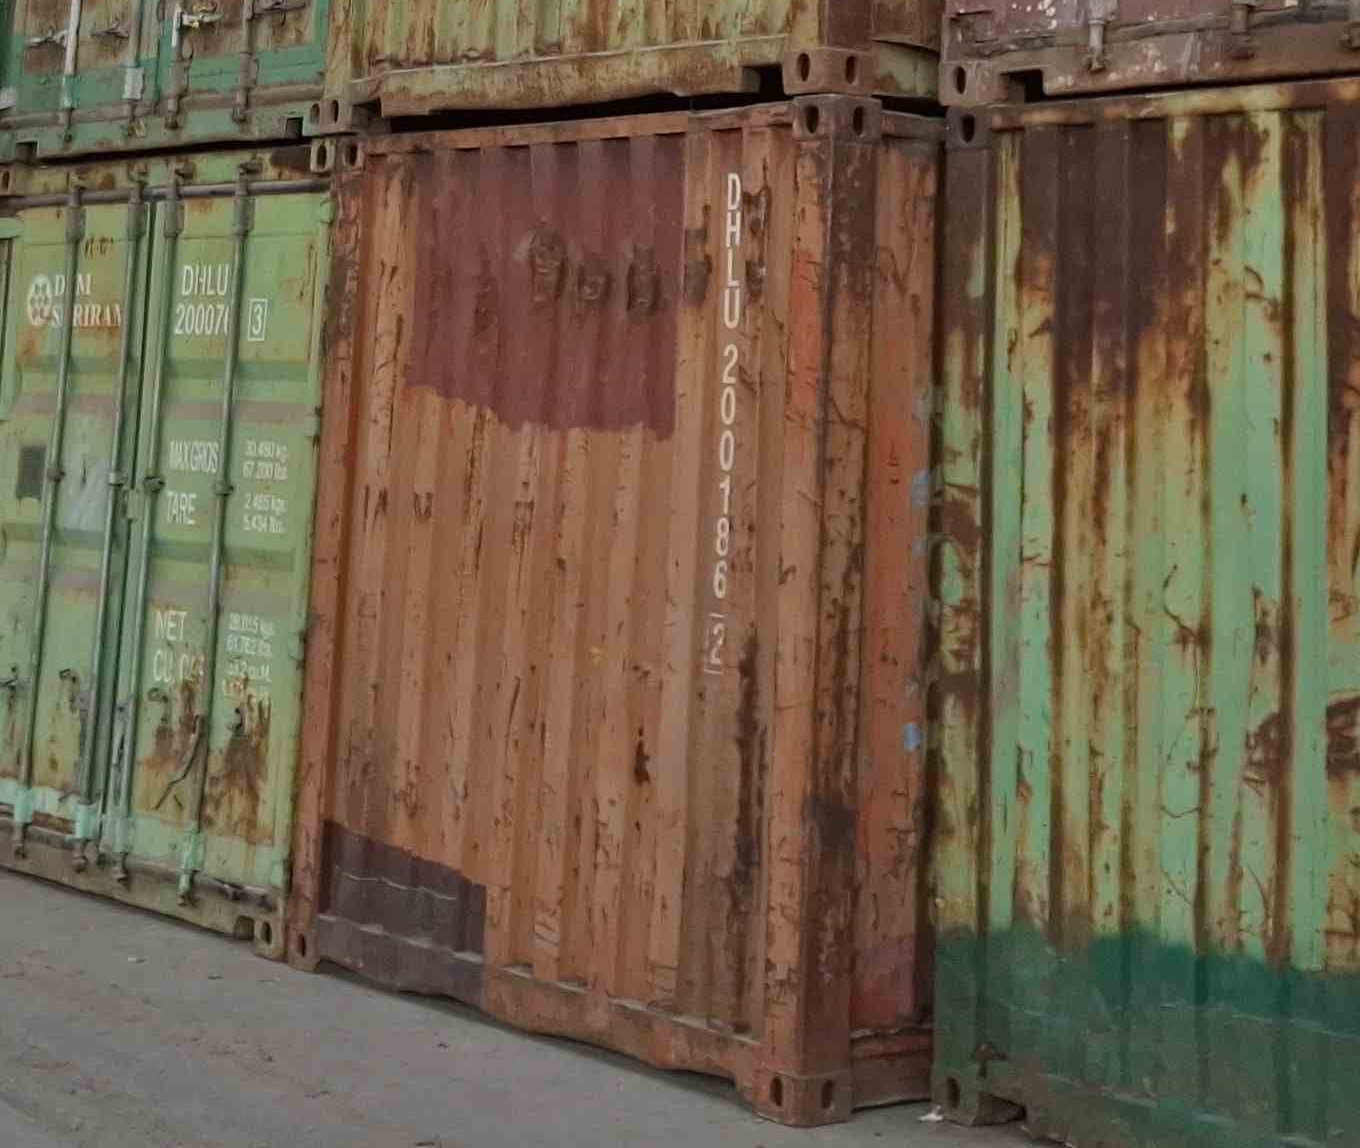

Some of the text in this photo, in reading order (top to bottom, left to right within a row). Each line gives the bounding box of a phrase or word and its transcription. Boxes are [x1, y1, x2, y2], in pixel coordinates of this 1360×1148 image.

[182, 263, 230, 296] DHLU
[709, 172, 742, 665] DHLU 200186 2
[165, 490, 197, 525] TARE
[154, 609, 188, 642] NET
